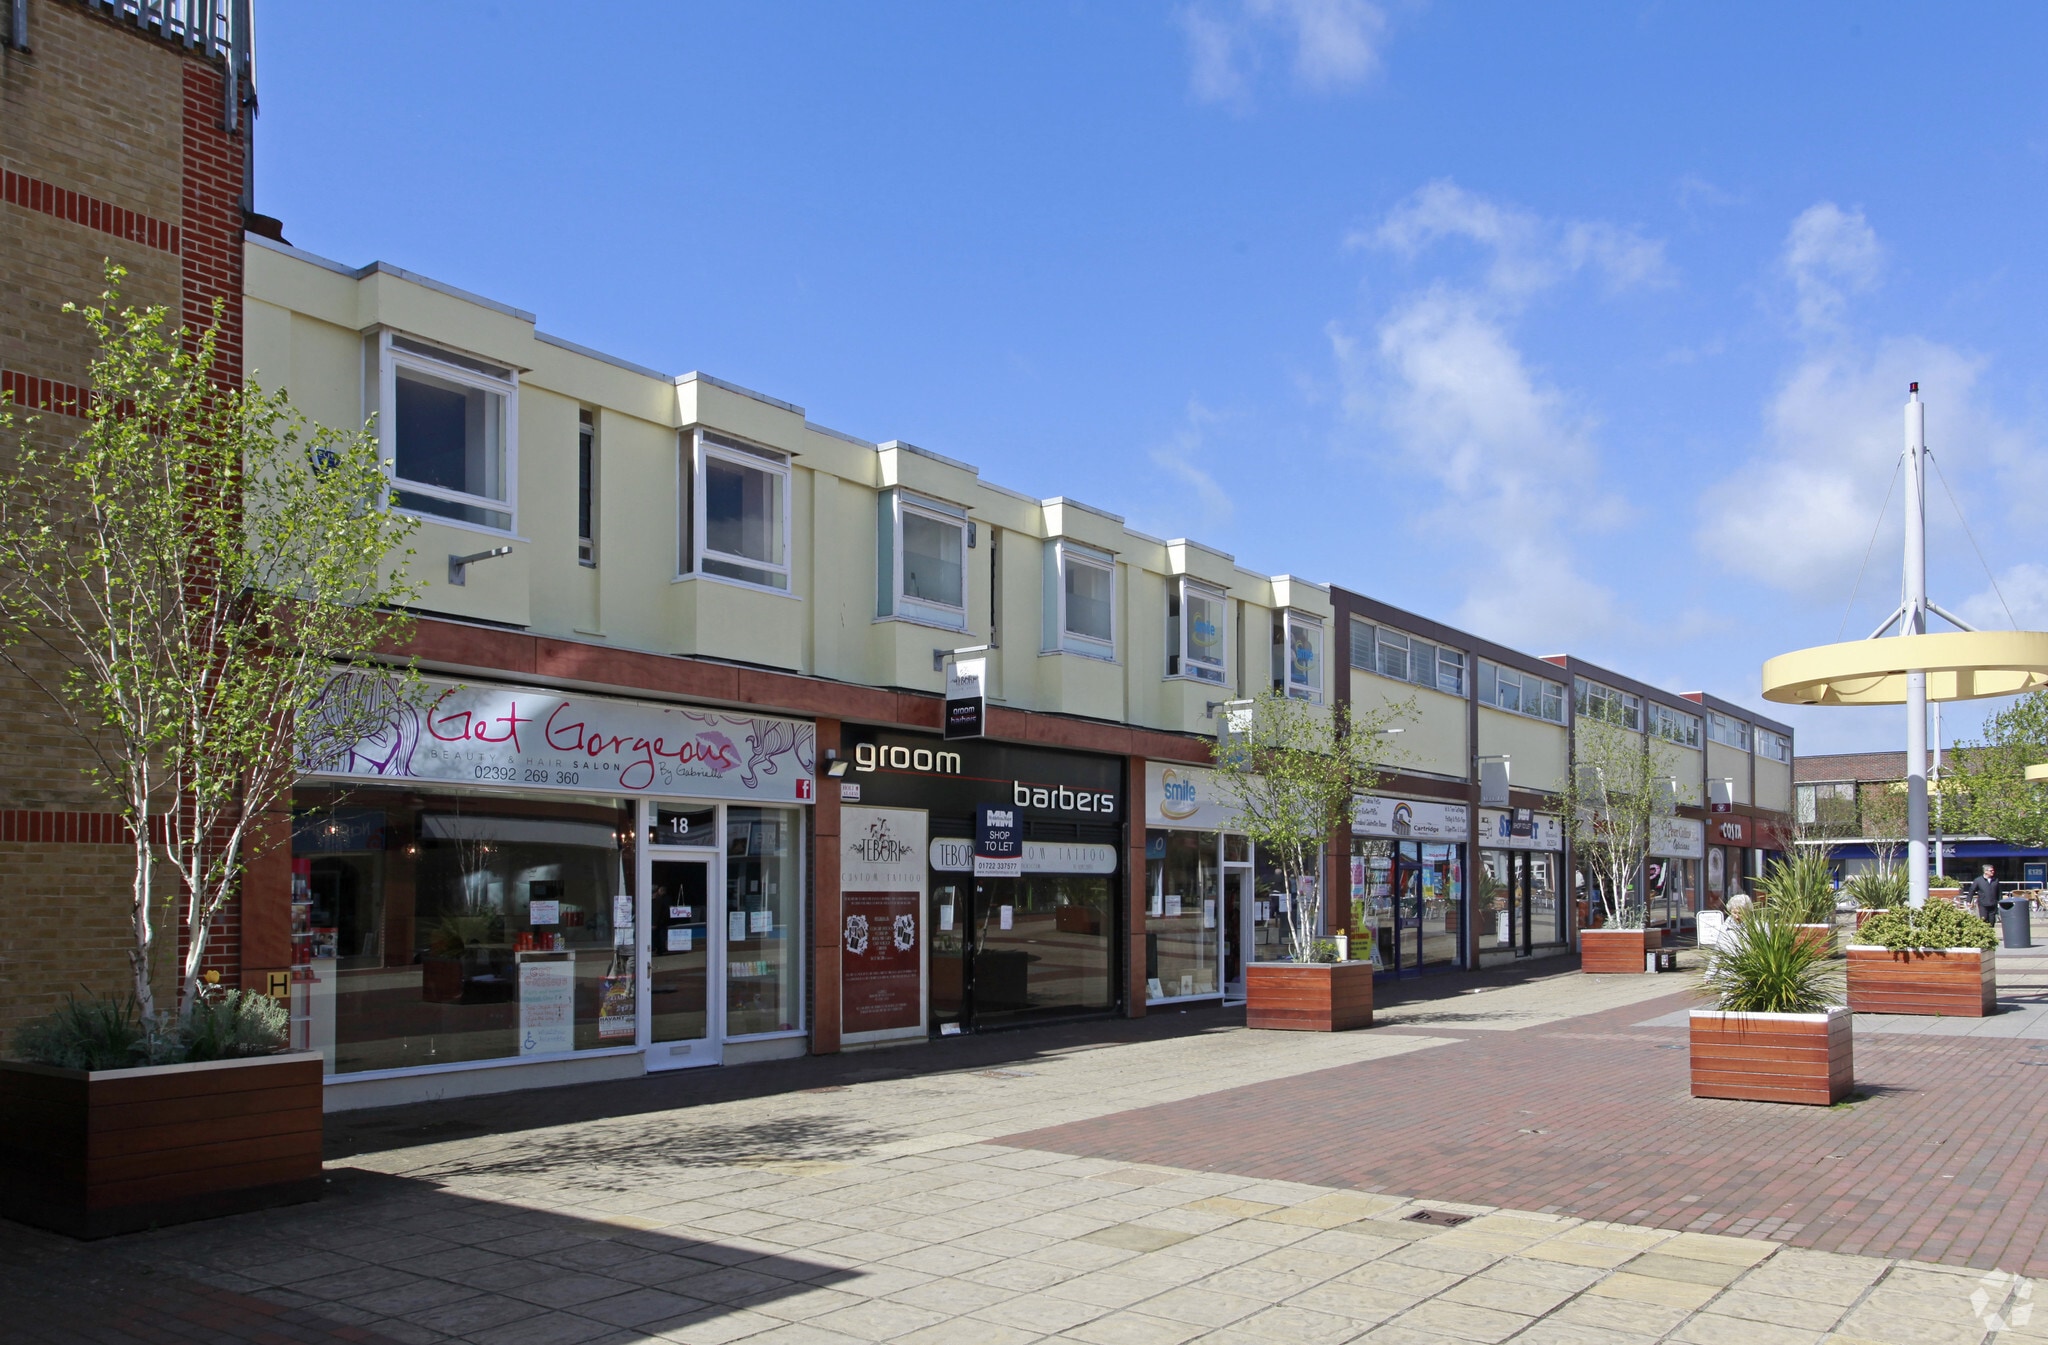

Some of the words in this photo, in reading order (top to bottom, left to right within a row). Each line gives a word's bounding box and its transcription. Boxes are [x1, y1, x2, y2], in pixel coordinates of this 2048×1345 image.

[1195, 620, 1216, 636] smile
[953, 706, 975, 715] groom
[426, 689, 533, 753] Get
[545, 702, 732, 789] Gorgeous
[430, 750, 497, 765] BEAUTY
[508, 756, 515, 765] &
[527, 757, 563, 769] HAIR
[573, 761, 621, 772] SALON
[855, 743, 961, 774] groom
[474, 765, 516, 781] 02392
[525, 769, 549, 783] 269
[556, 771, 579, 786] 360
[658, 762, 673, 785] By
[676, 763, 723, 779] Gabriella
[1014, 780, 1114, 813] barbers
[1165, 779, 1196, 802] smile
[670, 817, 689, 834] 18
[989, 831, 1010, 840] SHOP
[1413, 825, 1439, 833] Cartridge
[1722, 822, 1742, 841] COSTA
[861, 839, 900, 862] TEBORI
[940, 844, 974, 866] TEBOR
[985, 841, 997, 851] TO
[999, 841, 1014, 851] LET
[1059, 847, 1105, 861] TATTOO
[978, 862, 996, 870] 01722
[672, 908, 687, 916] Open
[270, 974, 288, 995] H
